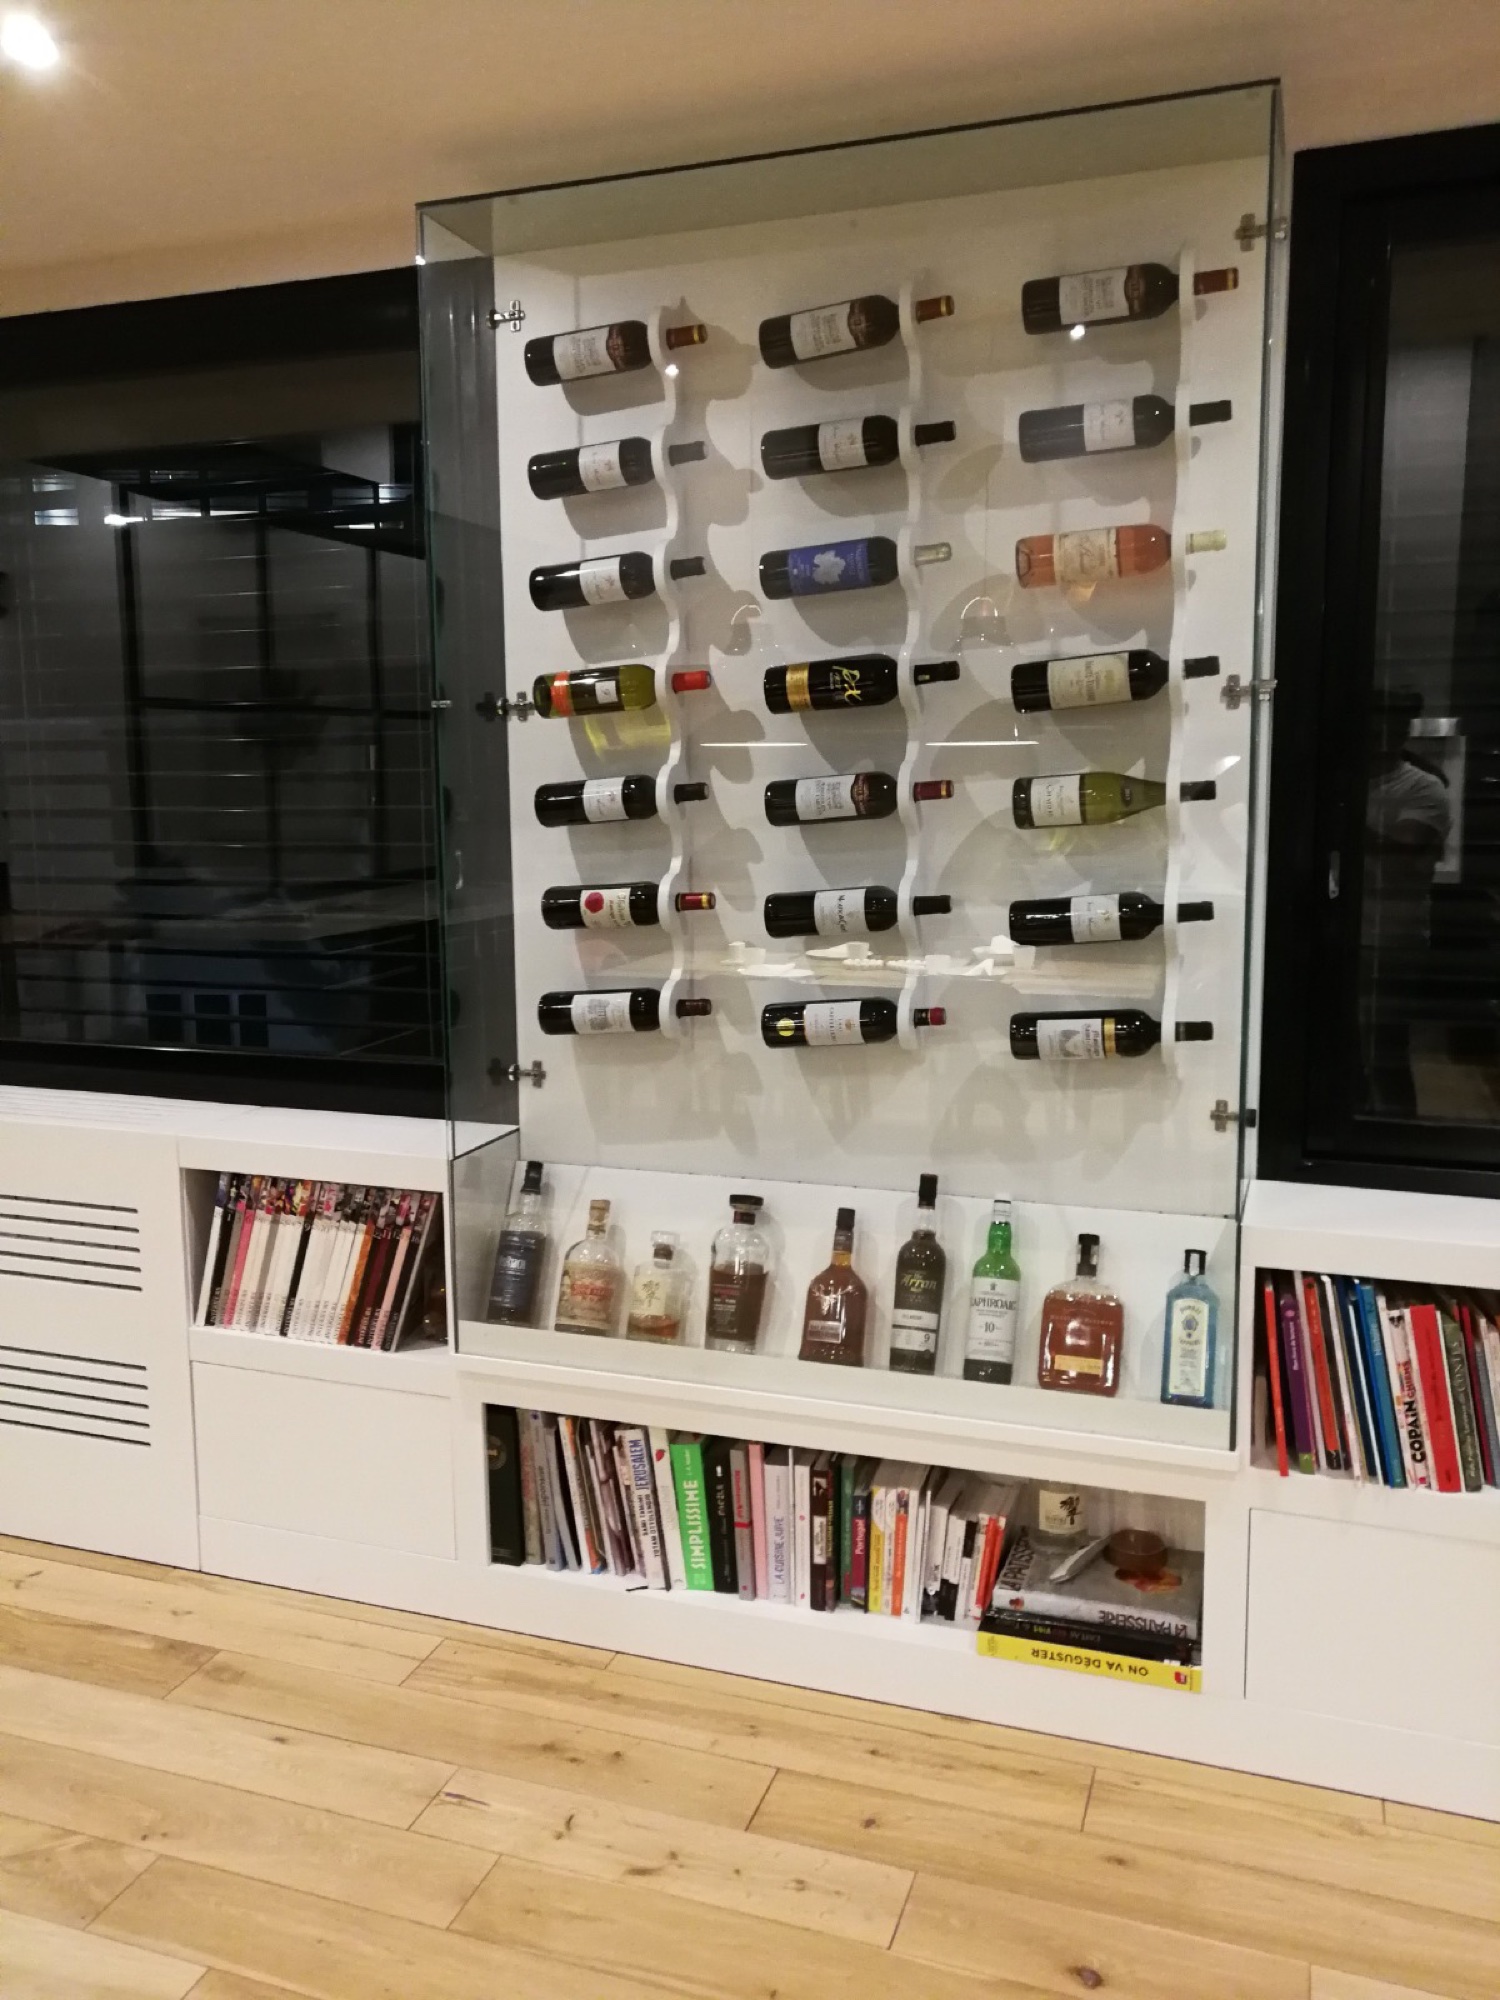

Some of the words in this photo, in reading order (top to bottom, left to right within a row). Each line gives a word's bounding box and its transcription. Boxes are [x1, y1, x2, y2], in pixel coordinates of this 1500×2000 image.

[984, 1321, 996, 1333] 10
[1403, 1400, 1427, 1463] COPAIN
[628, 1439, 650, 1491] JERUSALEM
[683, 1479, 707, 1569] SIMPLISSIME
[854, 1519, 867, 1555] Portugal
[1031, 1647, 1102, 1669] DÉGUSTER
[1106, 1660, 1124, 1673] VA
[1128, 1663, 1150, 1677] ON
